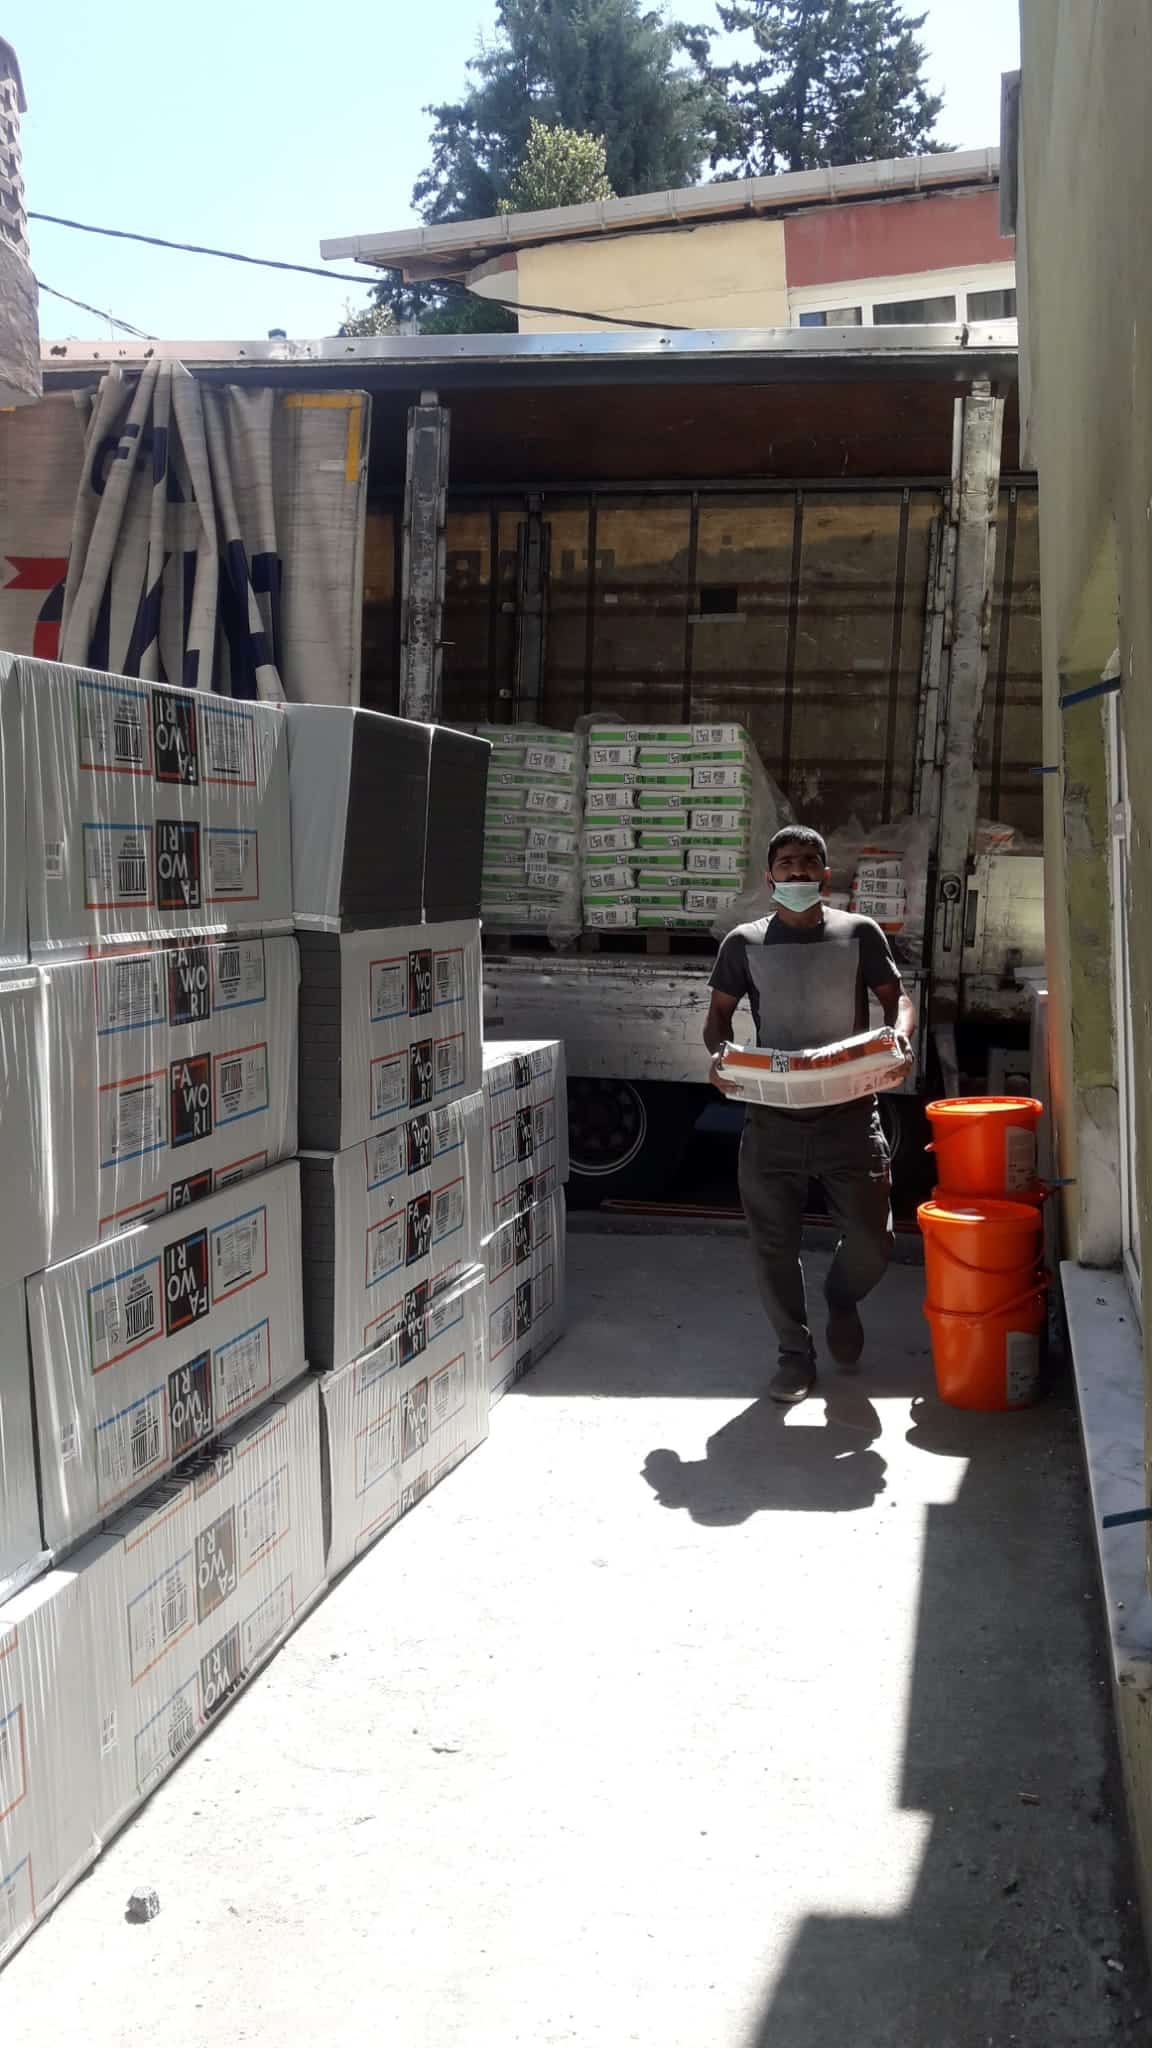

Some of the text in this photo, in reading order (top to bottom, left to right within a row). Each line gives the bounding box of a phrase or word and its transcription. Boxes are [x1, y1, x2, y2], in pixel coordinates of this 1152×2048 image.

[158, 696, 176, 725] RI
[162, 826, 178, 850] RI
[158, 853, 188, 879] WO
[180, 880, 198, 904] FA
[410, 954, 420, 972] FA
[180, 965, 208, 992] WO
[416, 972, 431, 990] WO
[191, 992, 206, 1016] RI
[420, 991, 430, 1010] RI
[411, 1046, 421, 1064] FA
[172, 1064, 192, 1090] FA
[417, 1062, 432, 1081] WO
[184, 1083, 209, 1112] WO
[422, 1081, 431, 1099] RI
[194, 1112, 207, 1136] RI
[414, 1126, 430, 1146] WO
[173, 1184, 191, 1210] FA
[408, 1202, 419, 1221] FA
[414, 1214, 430, 1238] WO
[171, 1243, 186, 1274] RI
[168, 1266, 196, 1301] WO
[189, 1286, 208, 1316] FA
[406, 1294, 416, 1314] FA
[174, 1368, 190, 1401] RI
[172, 1390, 202, 1428] WO
[409, 1403, 427, 1427] WO
[402, 1492, 414, 1512] FA
[198, 1549, 226, 1590] WO
[218, 1563, 236, 1596] FA
[204, 1667, 230, 1708] WO
